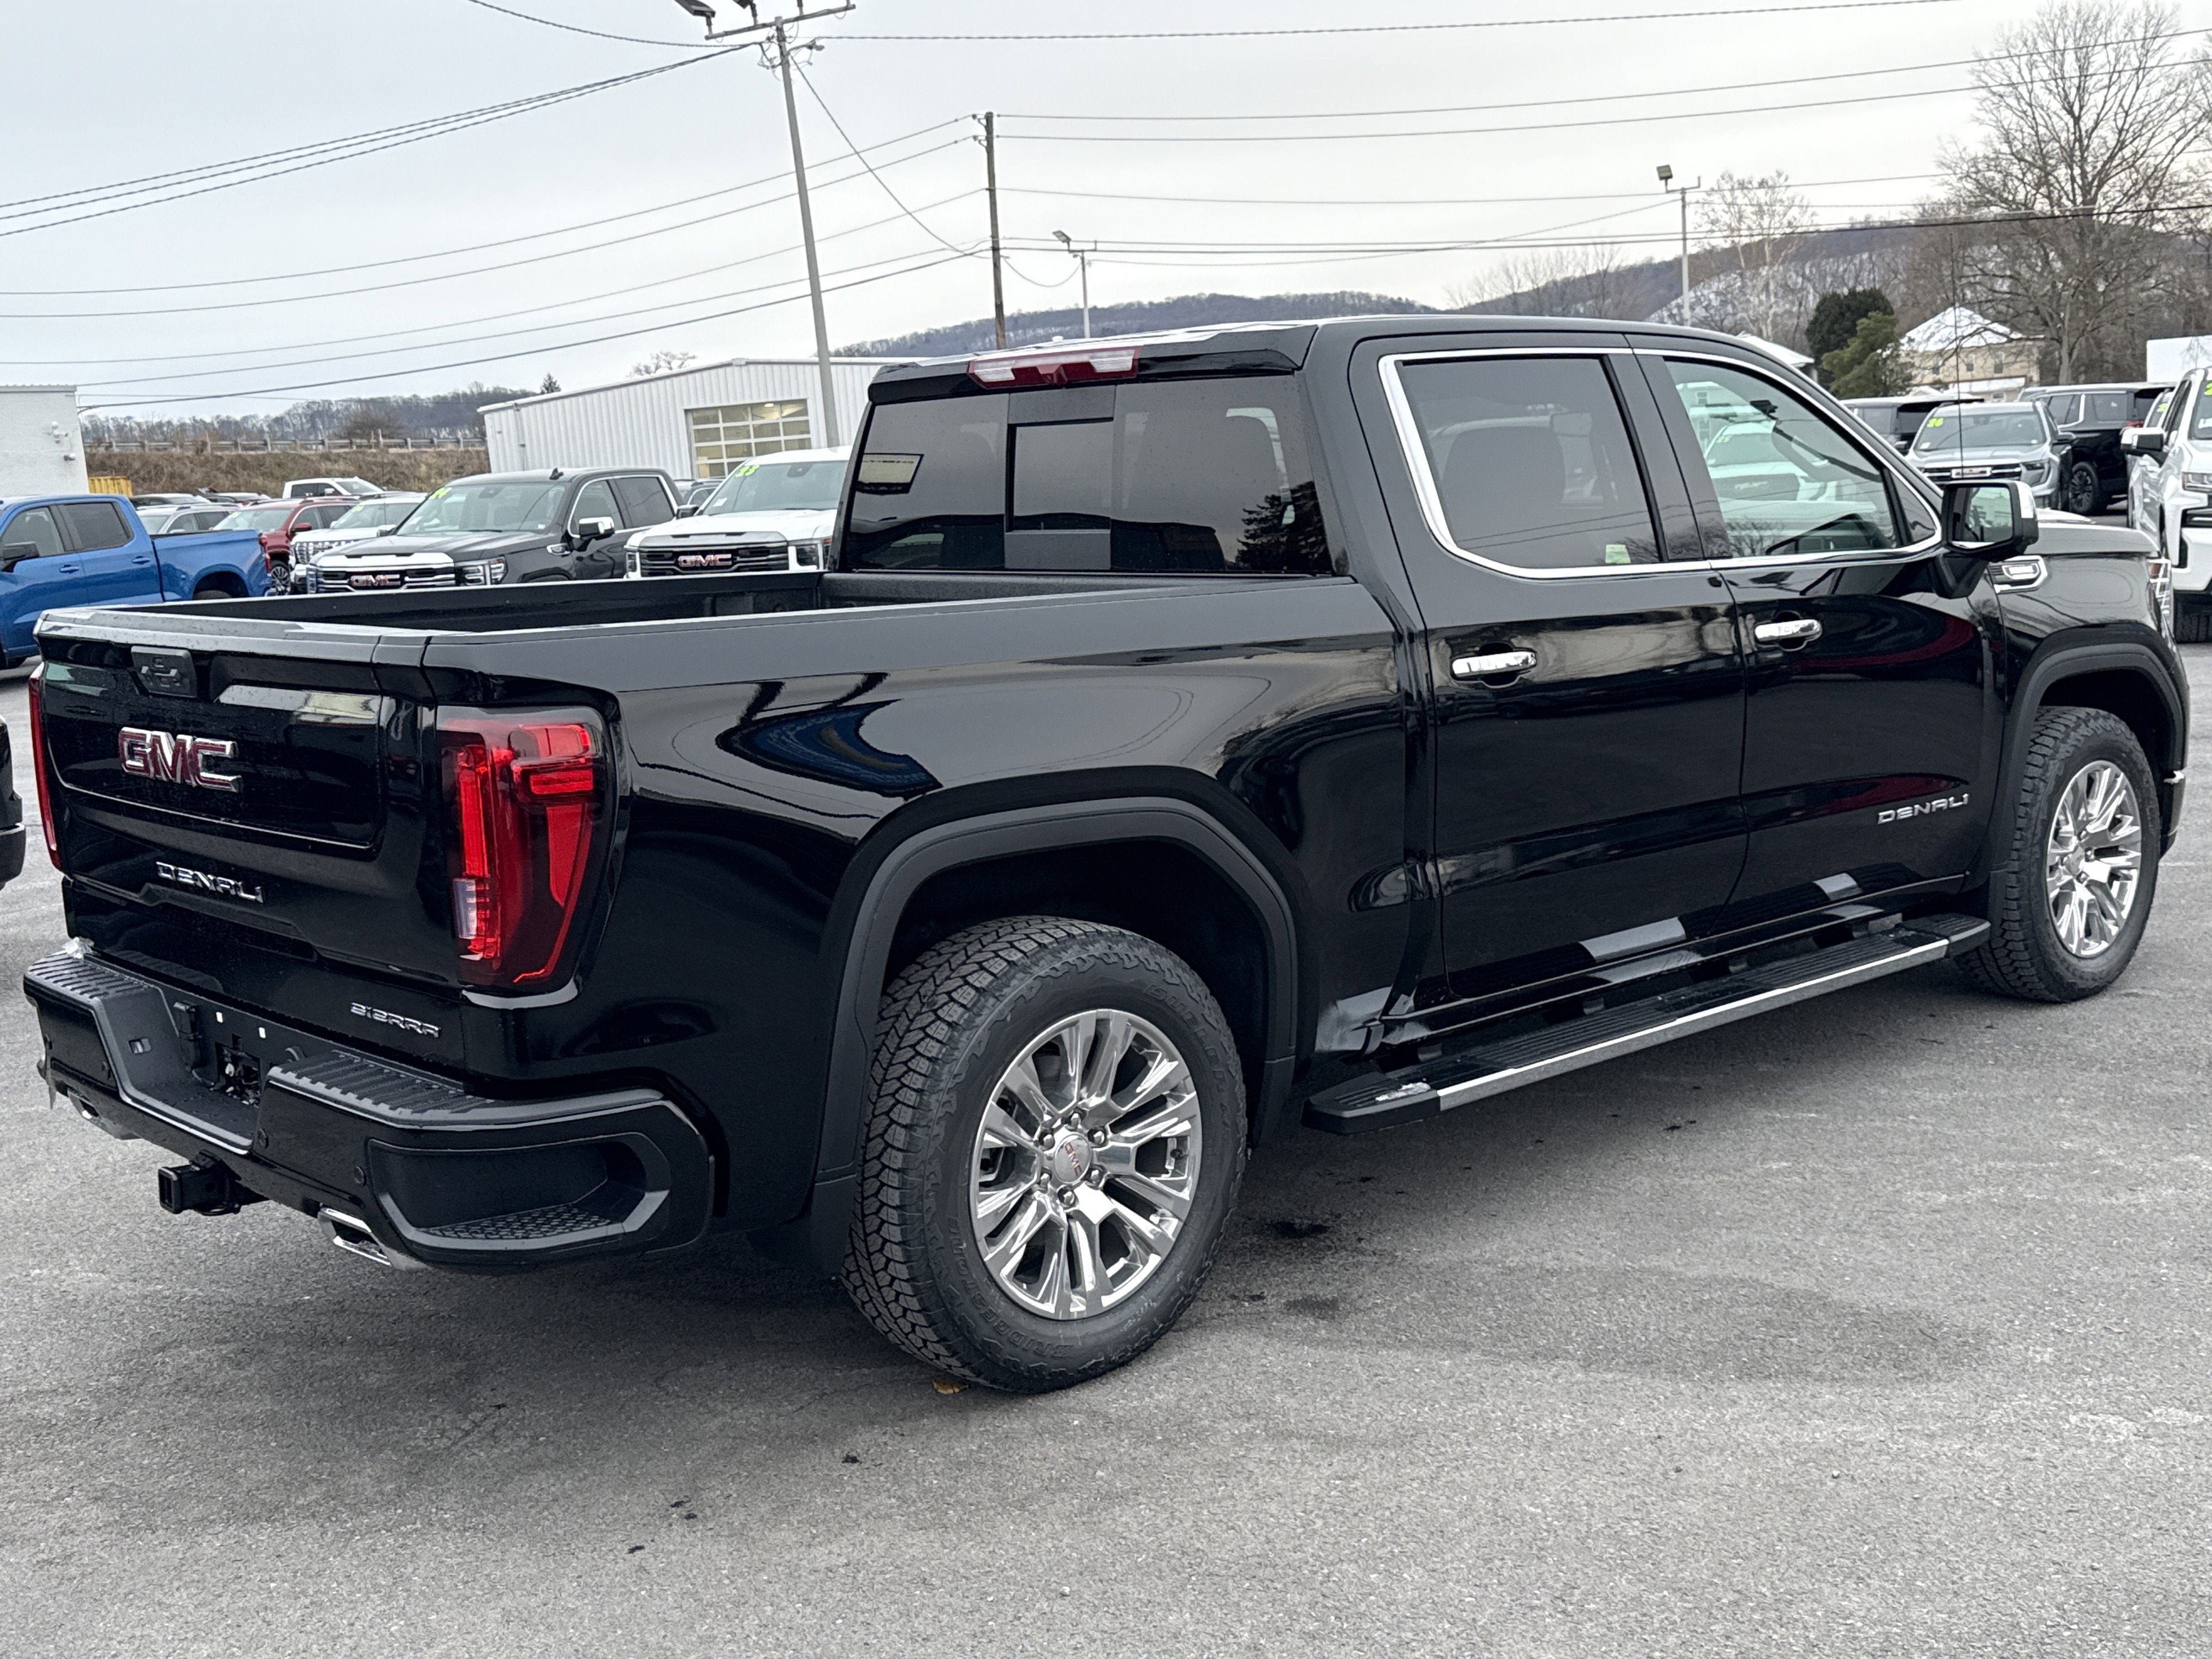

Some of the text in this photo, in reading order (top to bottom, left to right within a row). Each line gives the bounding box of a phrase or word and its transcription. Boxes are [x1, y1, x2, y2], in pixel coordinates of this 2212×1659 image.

[678, 554, 732, 567] GMC
[350, 574, 401, 586] GMC
[118, 726, 243, 793] GMC
[1877, 793, 1970, 825] DENALI
[156, 861, 264, 904] DENALI
[350, 1002, 441, 1038] SIERRA
[1063, 1142, 1082, 1177] GMC
[945, 1214, 1071, 1358] BRIDGESTONE
